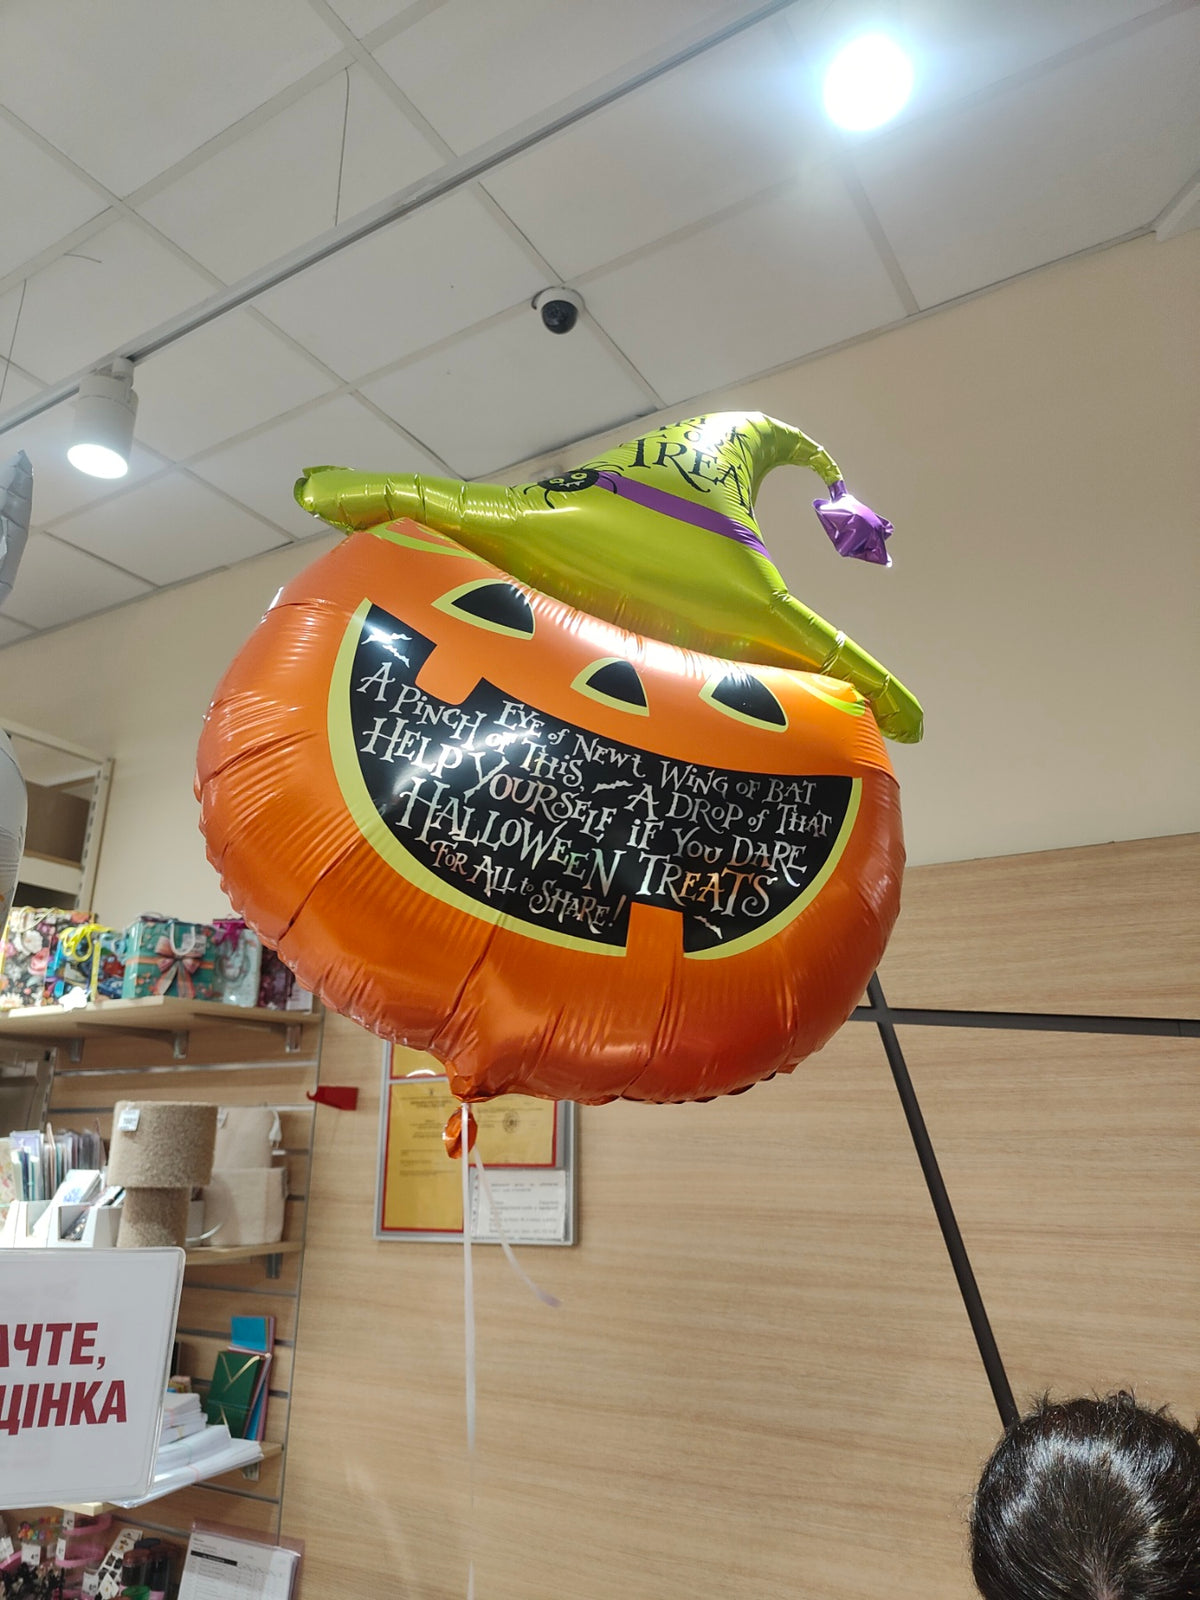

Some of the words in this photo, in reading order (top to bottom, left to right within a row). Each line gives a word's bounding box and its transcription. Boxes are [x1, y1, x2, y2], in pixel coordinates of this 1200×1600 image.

[356, 662, 396, 701] A
[624, 783, 660, 821] A
[665, 791, 744, 834] DROP
[748, 809, 770, 833] of
[775, 803, 833, 838] THAT
[360, 717, 463, 778] HELP
[463, 752, 617, 843] YOURSELF
[727, 834, 808, 888] DARE
[493, 700, 545, 738] EYE
[548, 729, 570, 745] of
[762, 778, 817, 805] BAT
[395, 776, 628, 898] HALLOWEEN
[635, 851, 778, 917] TREATS
[430, 839, 468, 875] FOR
[466, 855, 518, 898] ALL
[528, 879, 627, 935] SHARE!
